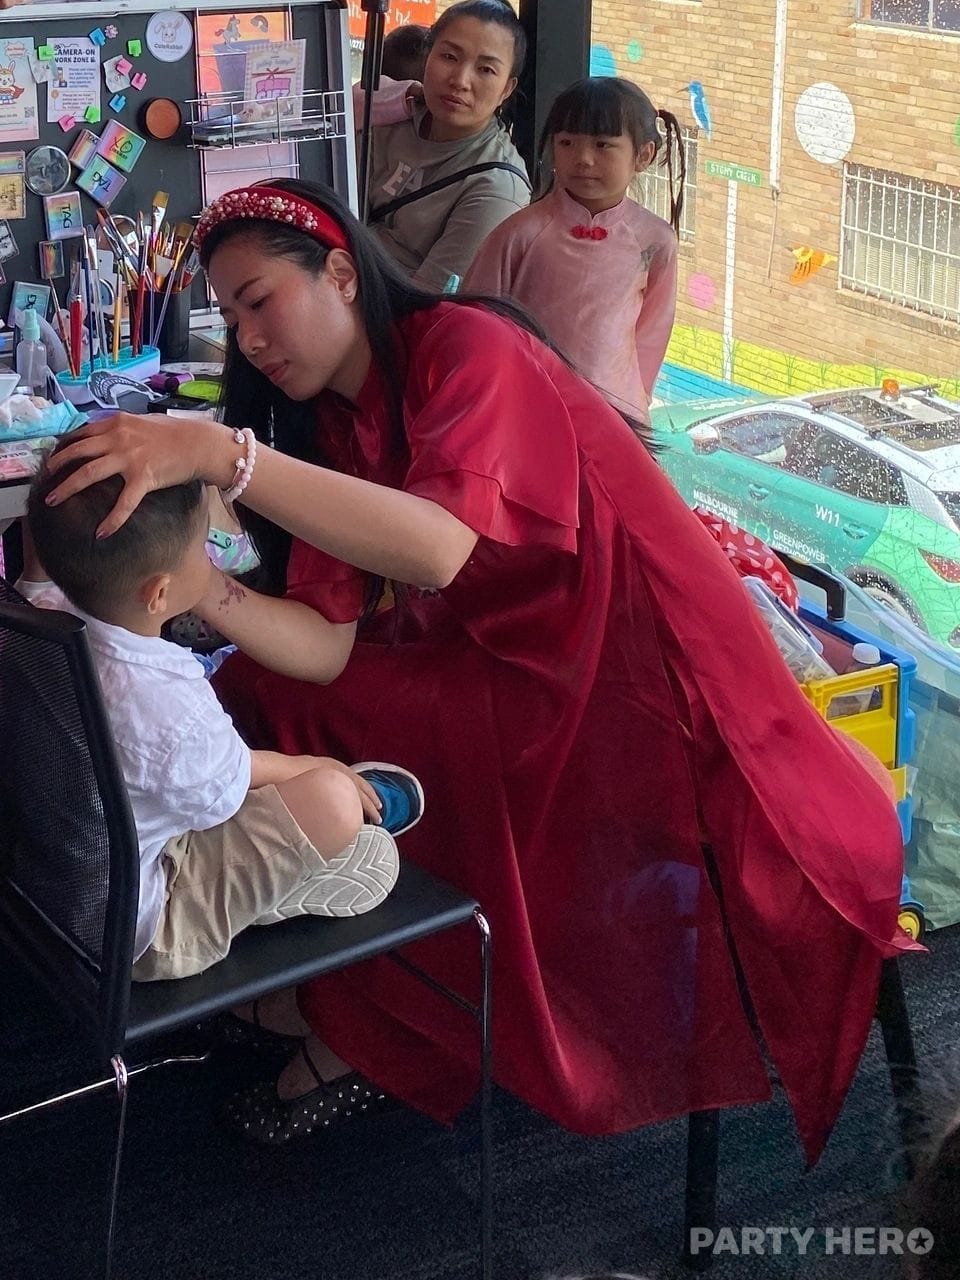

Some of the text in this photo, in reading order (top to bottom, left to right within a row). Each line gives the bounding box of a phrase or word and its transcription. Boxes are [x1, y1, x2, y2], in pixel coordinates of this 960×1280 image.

[93, 171, 112, 192] TAG
[735, 169, 757, 184] CREEK
[61, 203, 73, 229] TAG
[693, 489, 739, 519] MELBOURNE
[815, 503, 841, 528] W11
[773, 529, 826, 563] GREENPOWER
